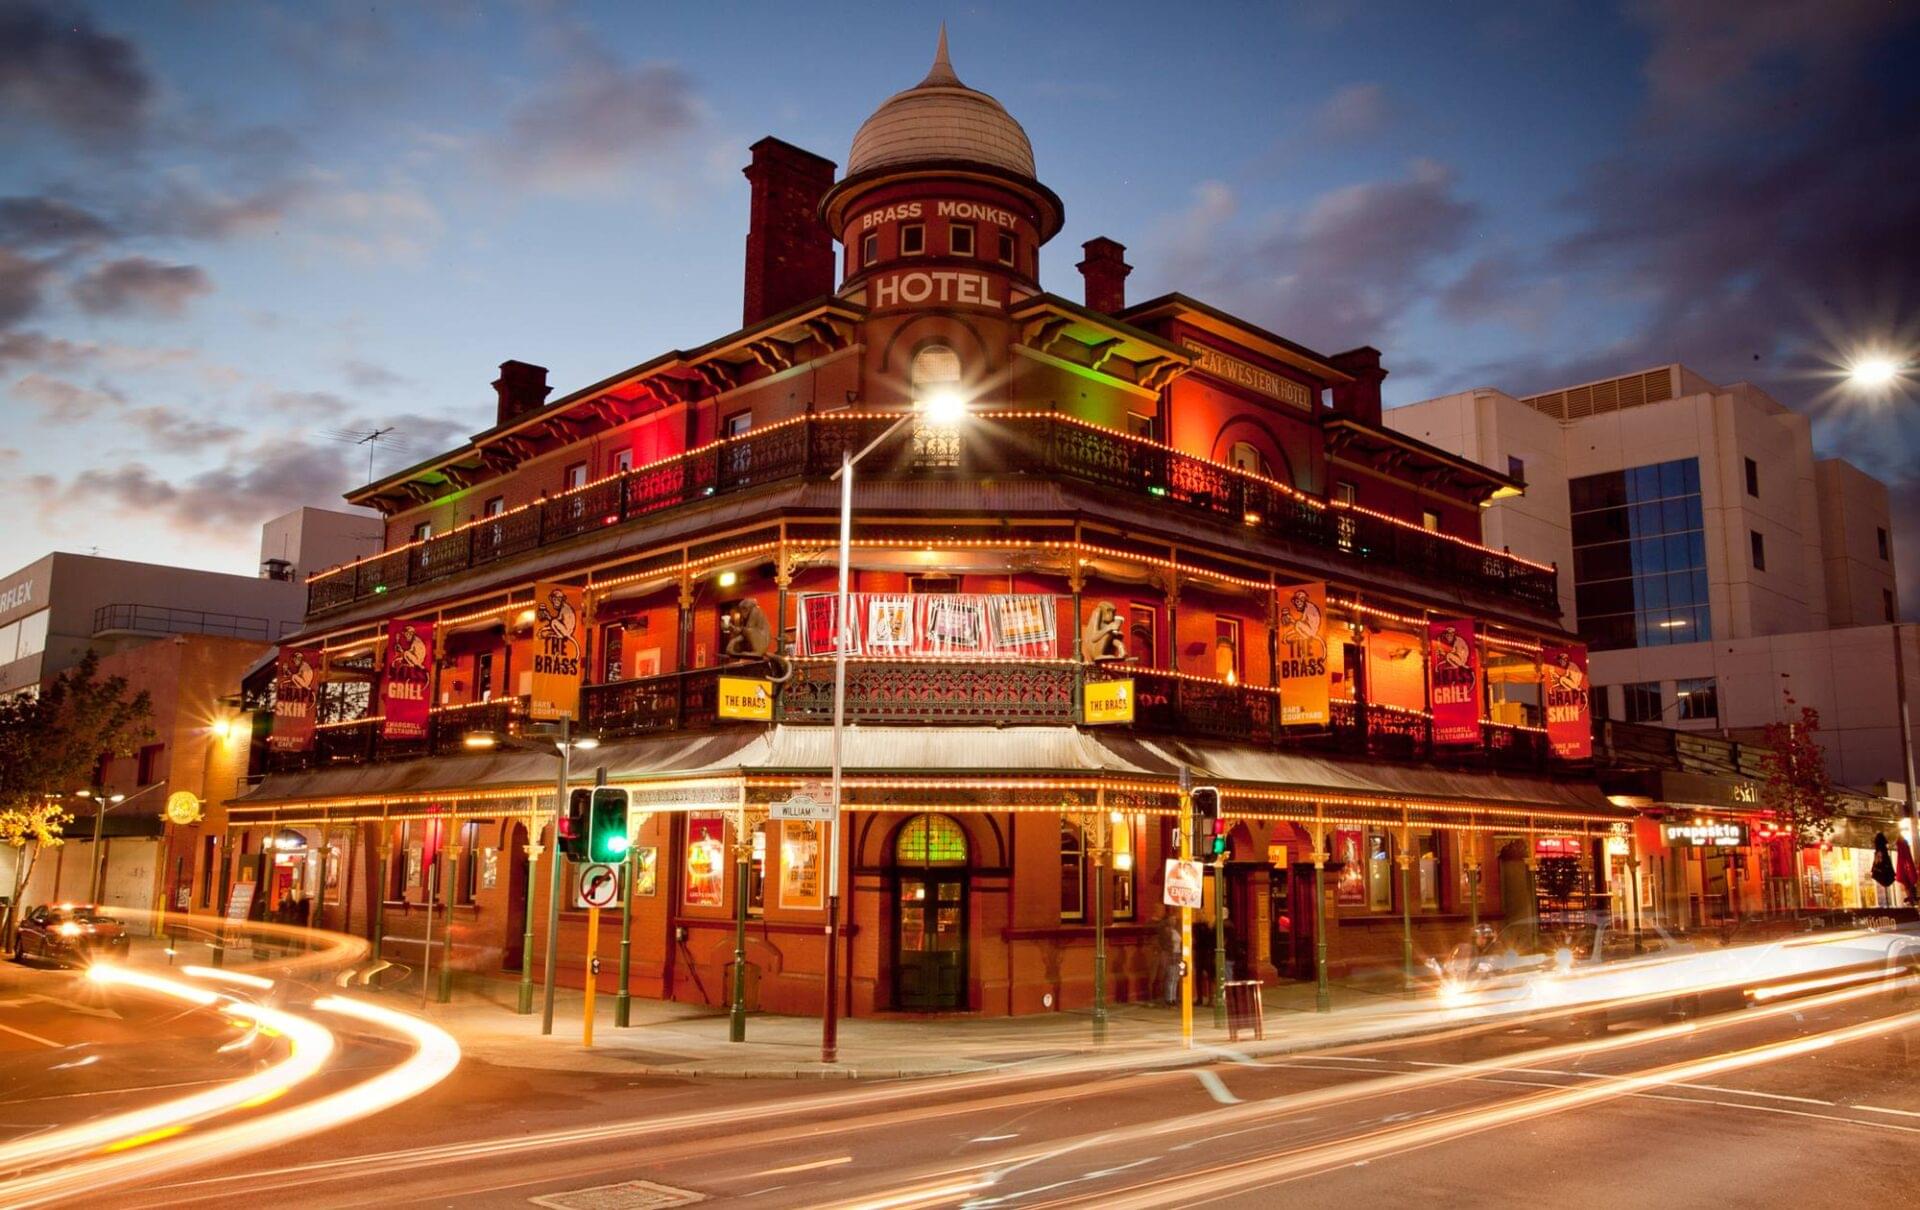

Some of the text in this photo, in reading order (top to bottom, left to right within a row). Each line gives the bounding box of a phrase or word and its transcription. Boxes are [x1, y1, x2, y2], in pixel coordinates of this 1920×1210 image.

[863, 201, 1019, 229] BRASS MONKEY
[876, 271, 1001, 308] HOTEL
[1226, 359, 1279, 396] WESTERN
[1281, 379, 1312, 408] HOTEL
[543, 635, 568, 656] THE
[1287, 638, 1314, 659] THE
[535, 655, 578, 676] BRASS
[1282, 657, 1326, 679] BRASS
[388, 681, 425, 700] GRILL
[1434, 685, 1472, 705] GRILL
[275, 701, 307, 718] SKIN
[725, 695, 766, 708] THE BRASS
[1090, 698, 1128, 711] THE BRASS
[1548, 705, 1579, 722] SKIN
[782, 807, 811, 817] WILLIAM
[1667, 823, 1740, 840] grapeskin
